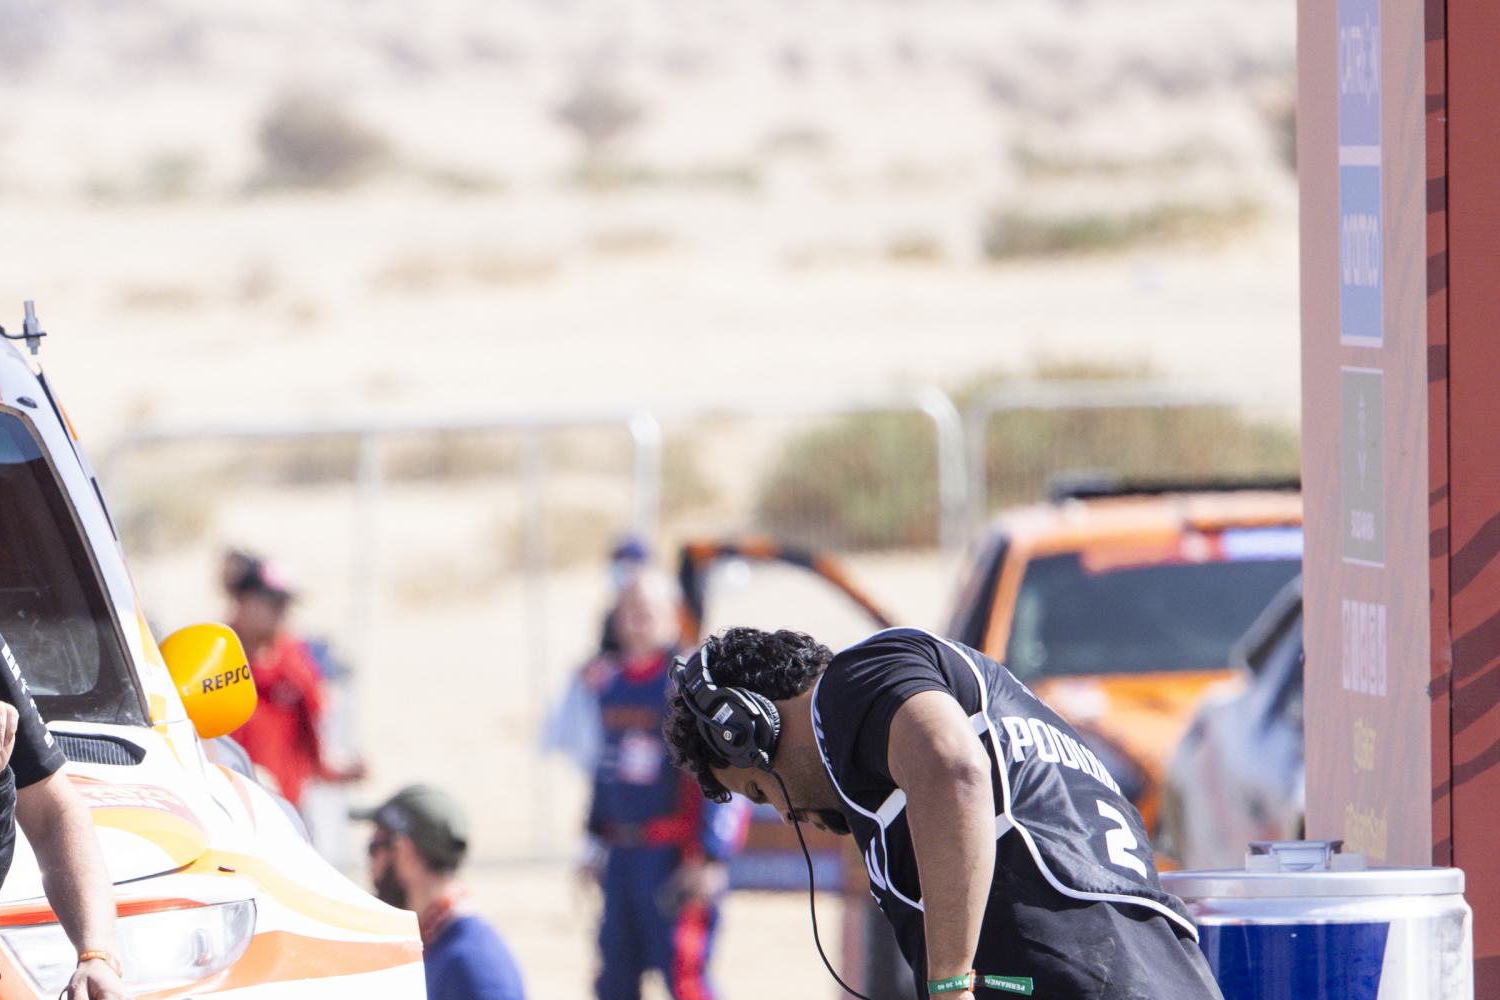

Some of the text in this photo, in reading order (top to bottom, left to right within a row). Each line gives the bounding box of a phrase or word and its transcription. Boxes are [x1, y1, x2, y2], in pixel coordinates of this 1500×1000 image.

[202, 664, 250, 694] REPSO
[1002, 716, 1121, 795] PODIUM
[1096, 799, 1147, 879] 2
[985, 978, 1026, 992] PERMANEN
